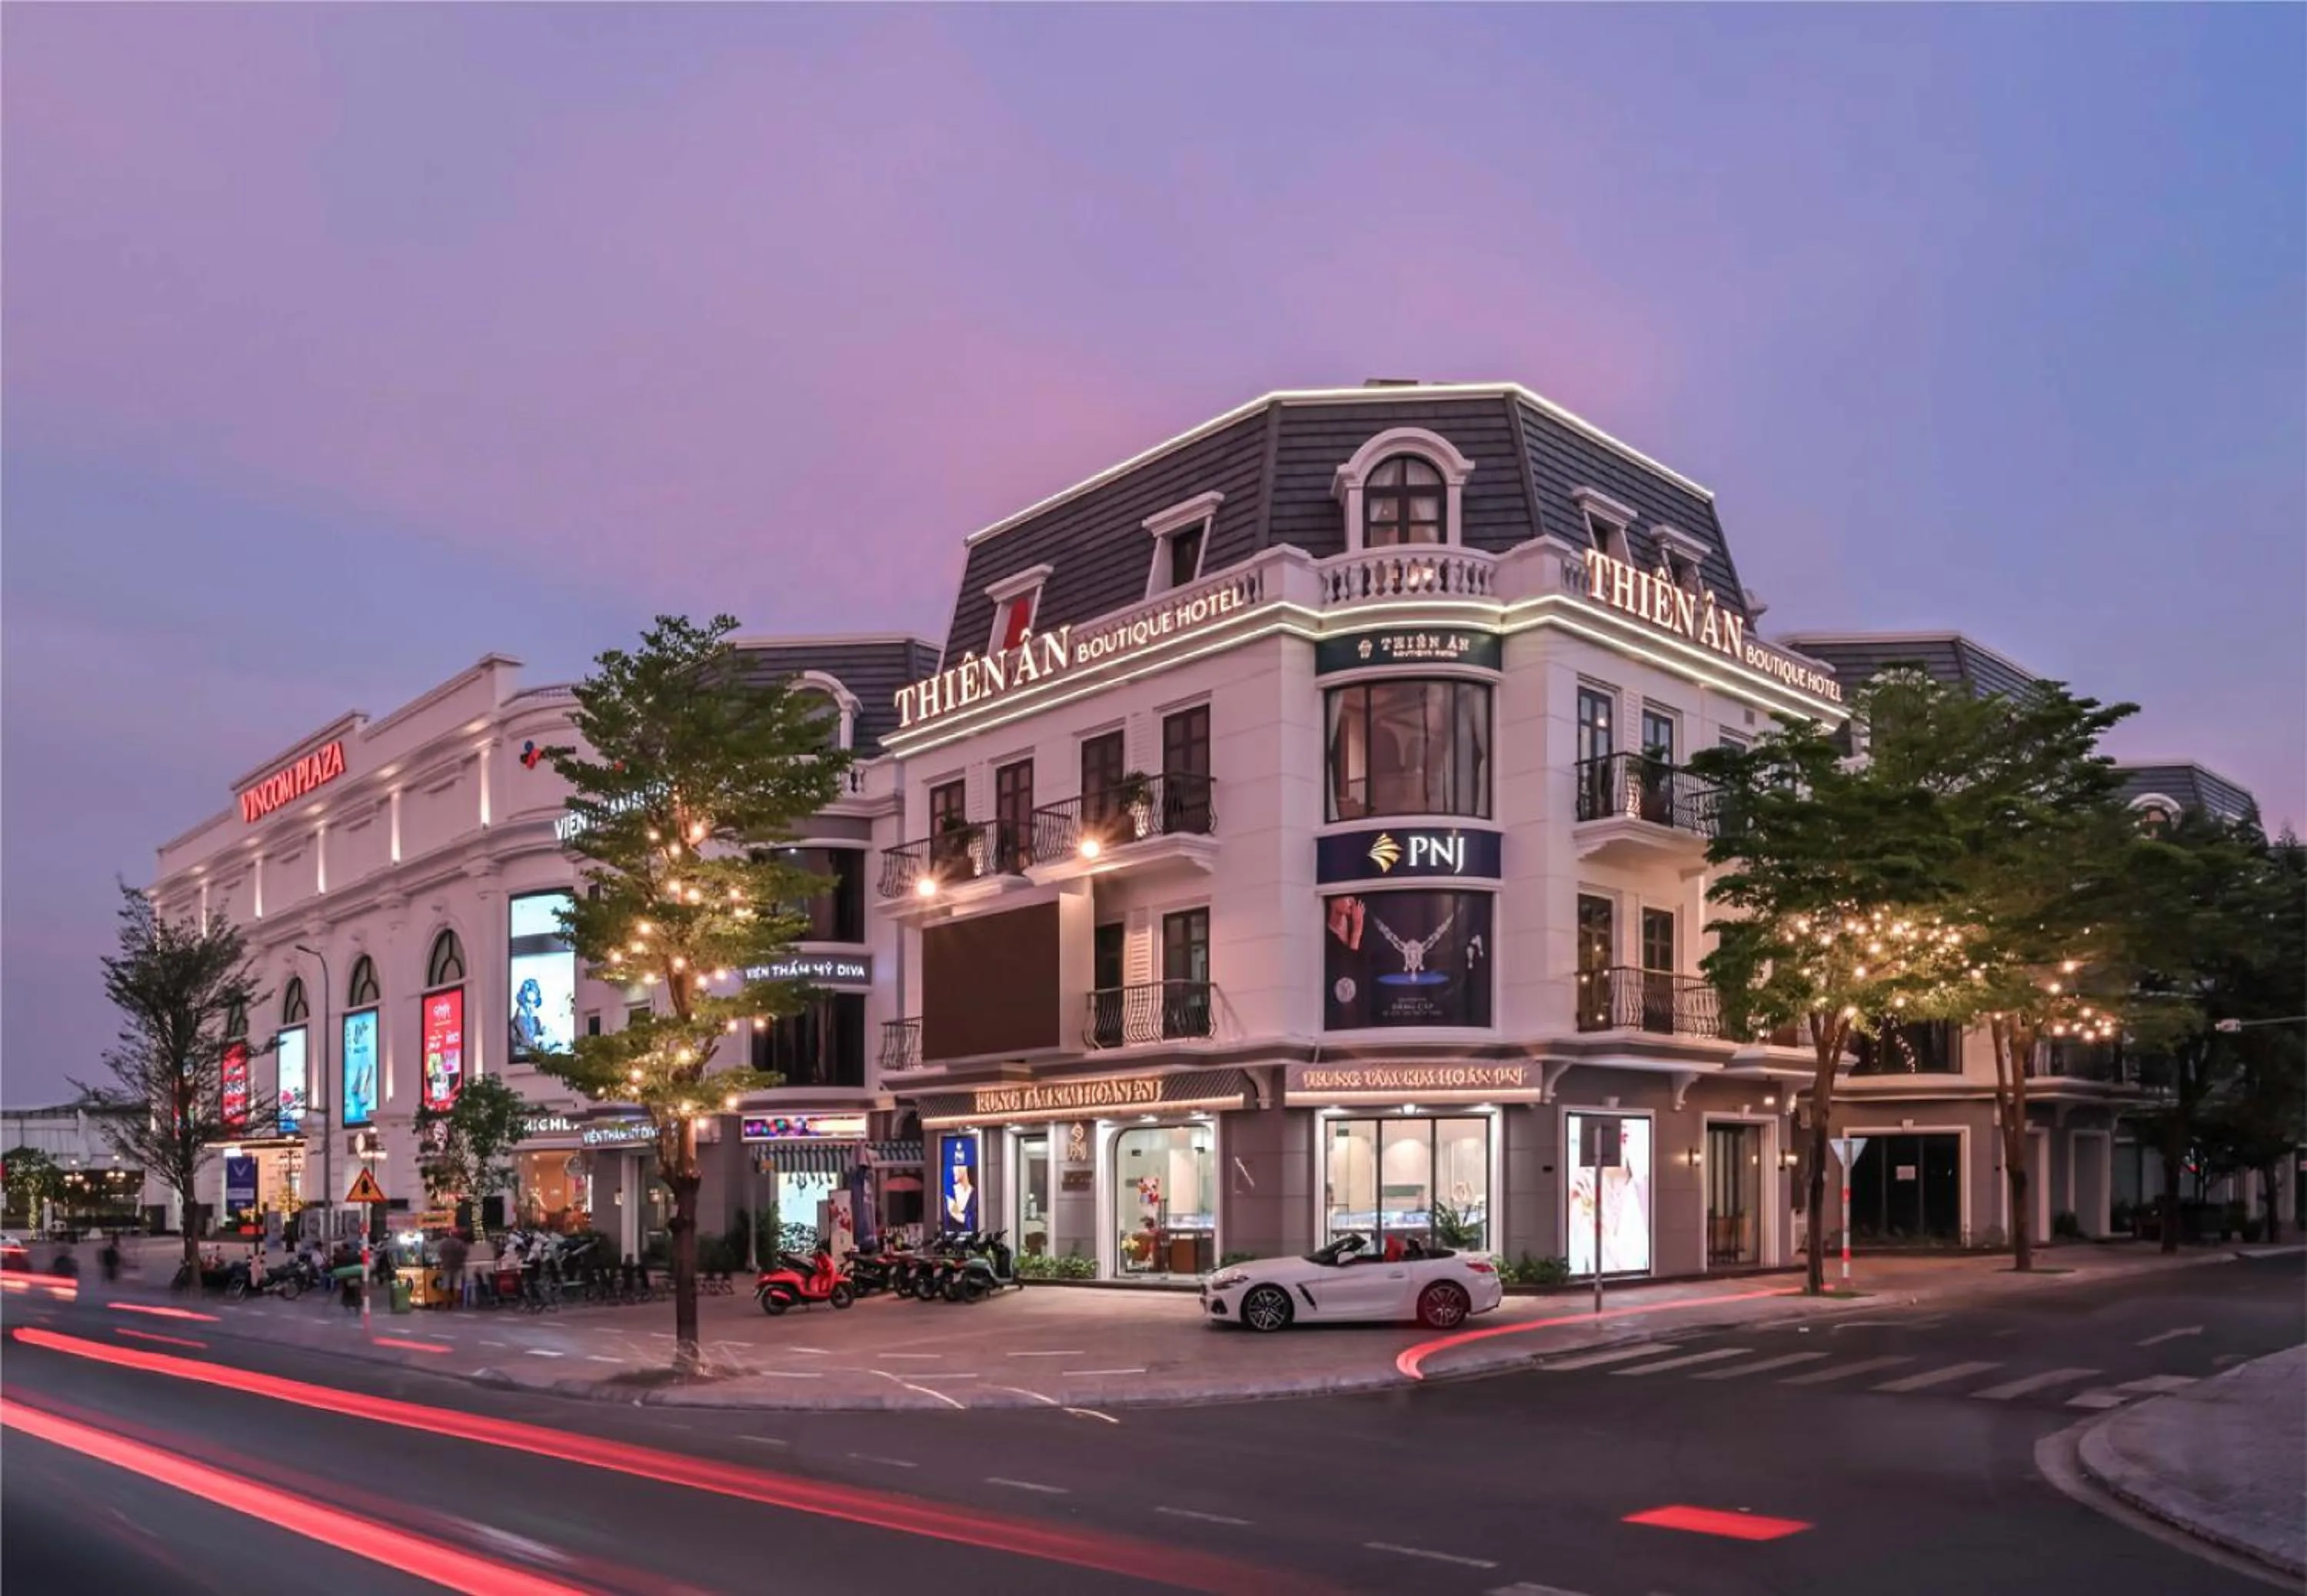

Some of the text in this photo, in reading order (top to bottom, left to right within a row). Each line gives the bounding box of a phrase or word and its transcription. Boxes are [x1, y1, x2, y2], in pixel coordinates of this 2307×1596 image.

[1077, 587, 1243, 663] BOUTIQUE HOTEL
[1586, 547, 1745, 659] THIÊN ÂN
[894, 624, 1071, 728] THIÊN ÂN
[1746, 644, 1843, 703] BOUTIQUE HOTEL
[241, 741, 345, 823] VINCOM PLAZA
[1408, 836, 1465, 873] PNJ
[837, 963, 865, 978] DIVA
